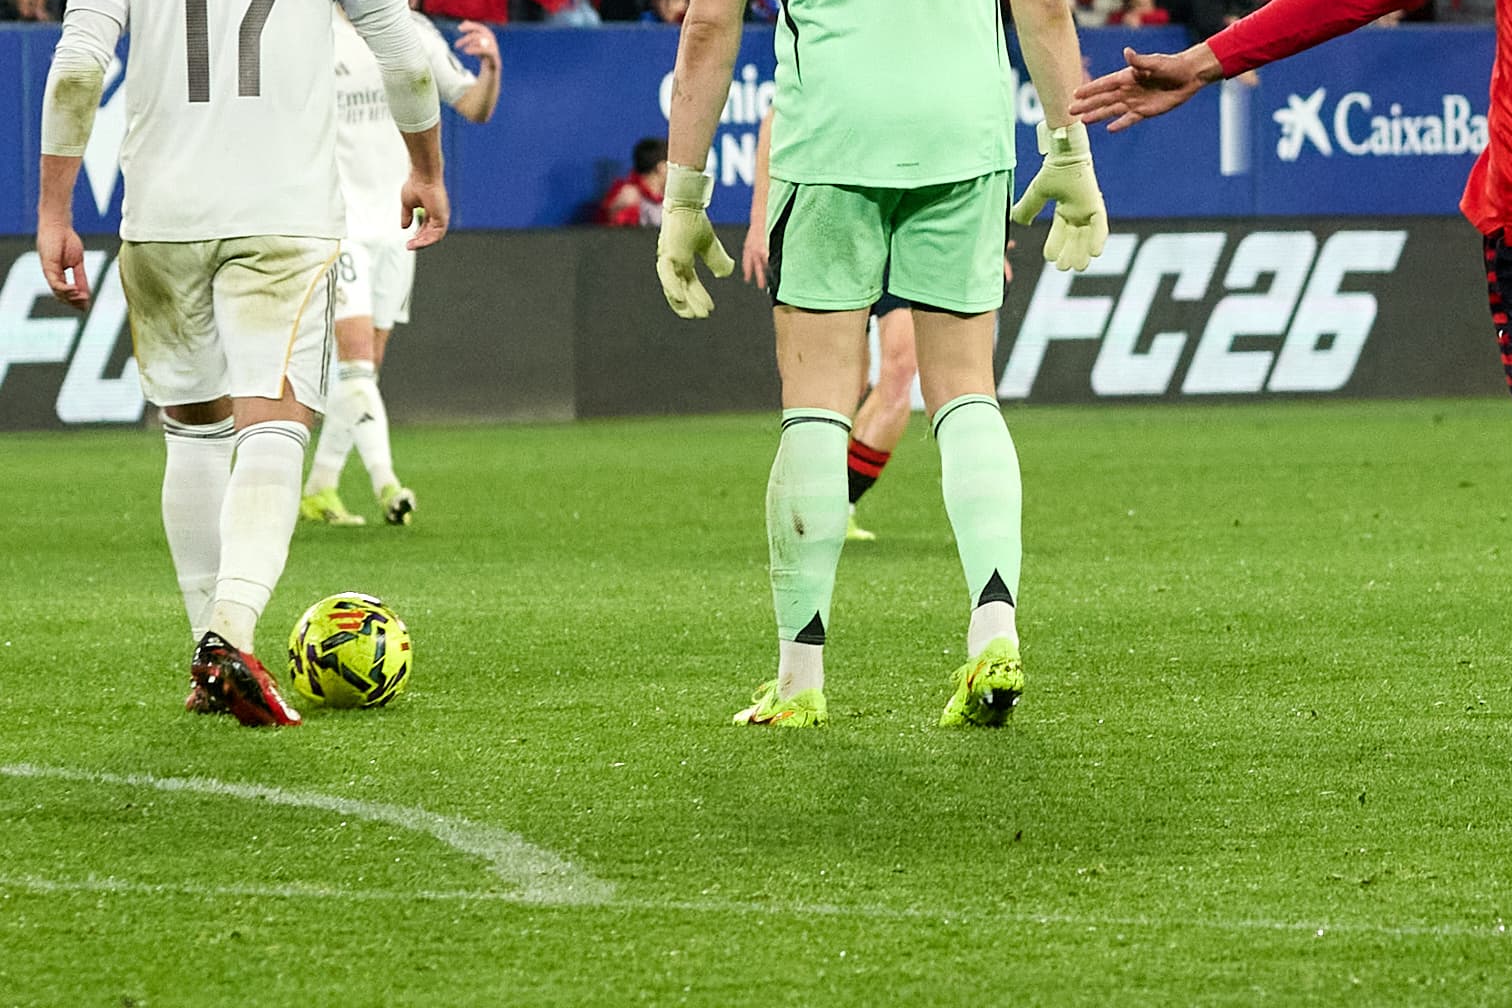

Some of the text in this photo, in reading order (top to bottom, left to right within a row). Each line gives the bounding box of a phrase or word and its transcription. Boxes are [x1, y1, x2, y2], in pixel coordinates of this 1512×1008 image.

[1333, 91, 1489, 156] CaixaBa
[0, 250, 145, 423] FC
[997, 230, 1409, 399] FC26
